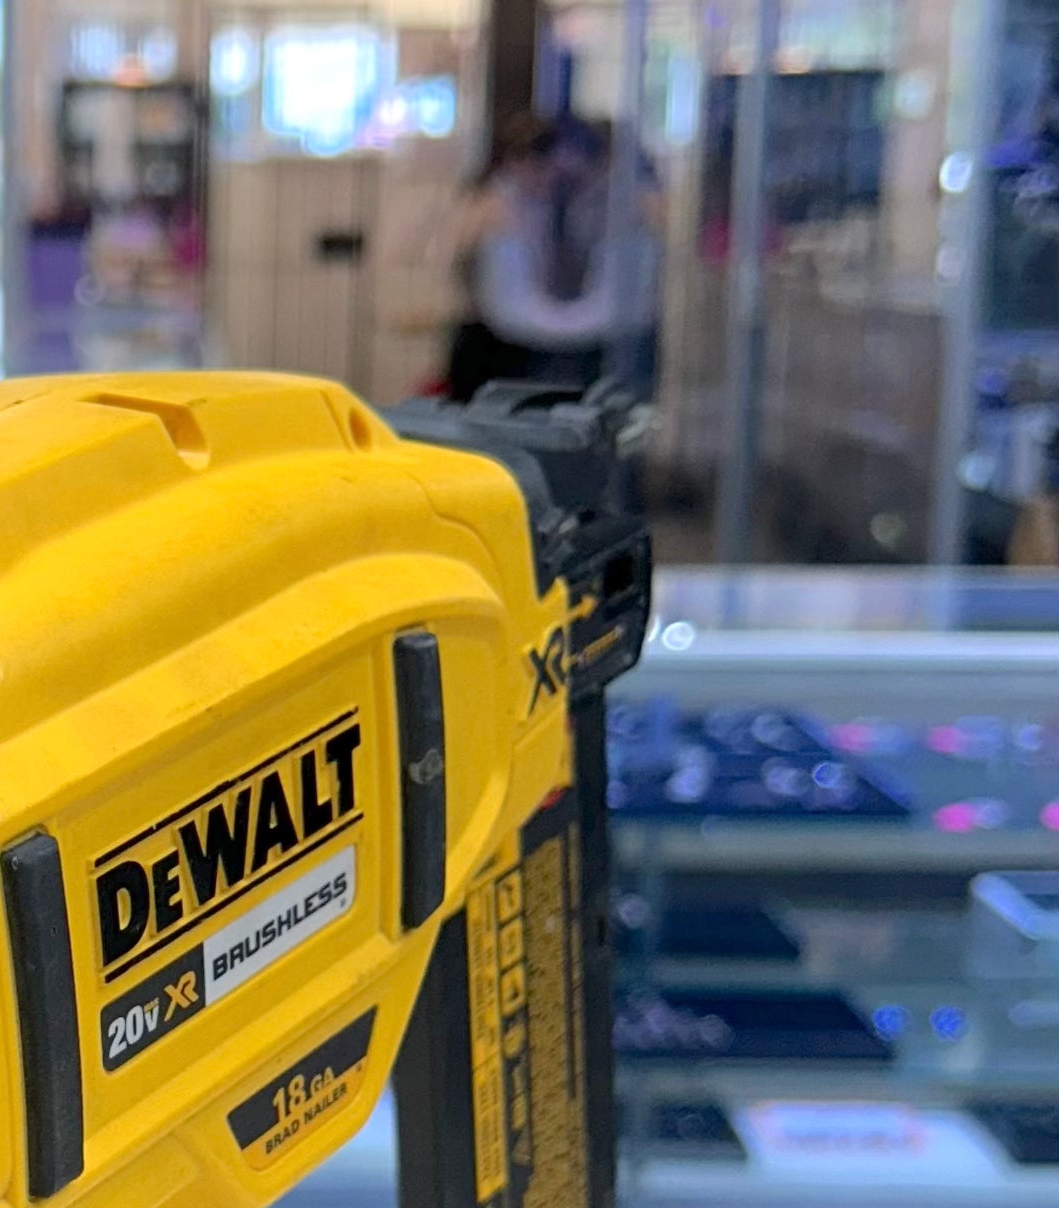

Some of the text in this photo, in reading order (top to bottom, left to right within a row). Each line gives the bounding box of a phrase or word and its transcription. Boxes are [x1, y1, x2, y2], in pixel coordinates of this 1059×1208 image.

[529, 626, 565, 717] XR
[212, 872, 348, 981] BRUSHLESS
[163, 970, 200, 1022] XR
[265, 1082, 348, 1154] BRAD NAILER
